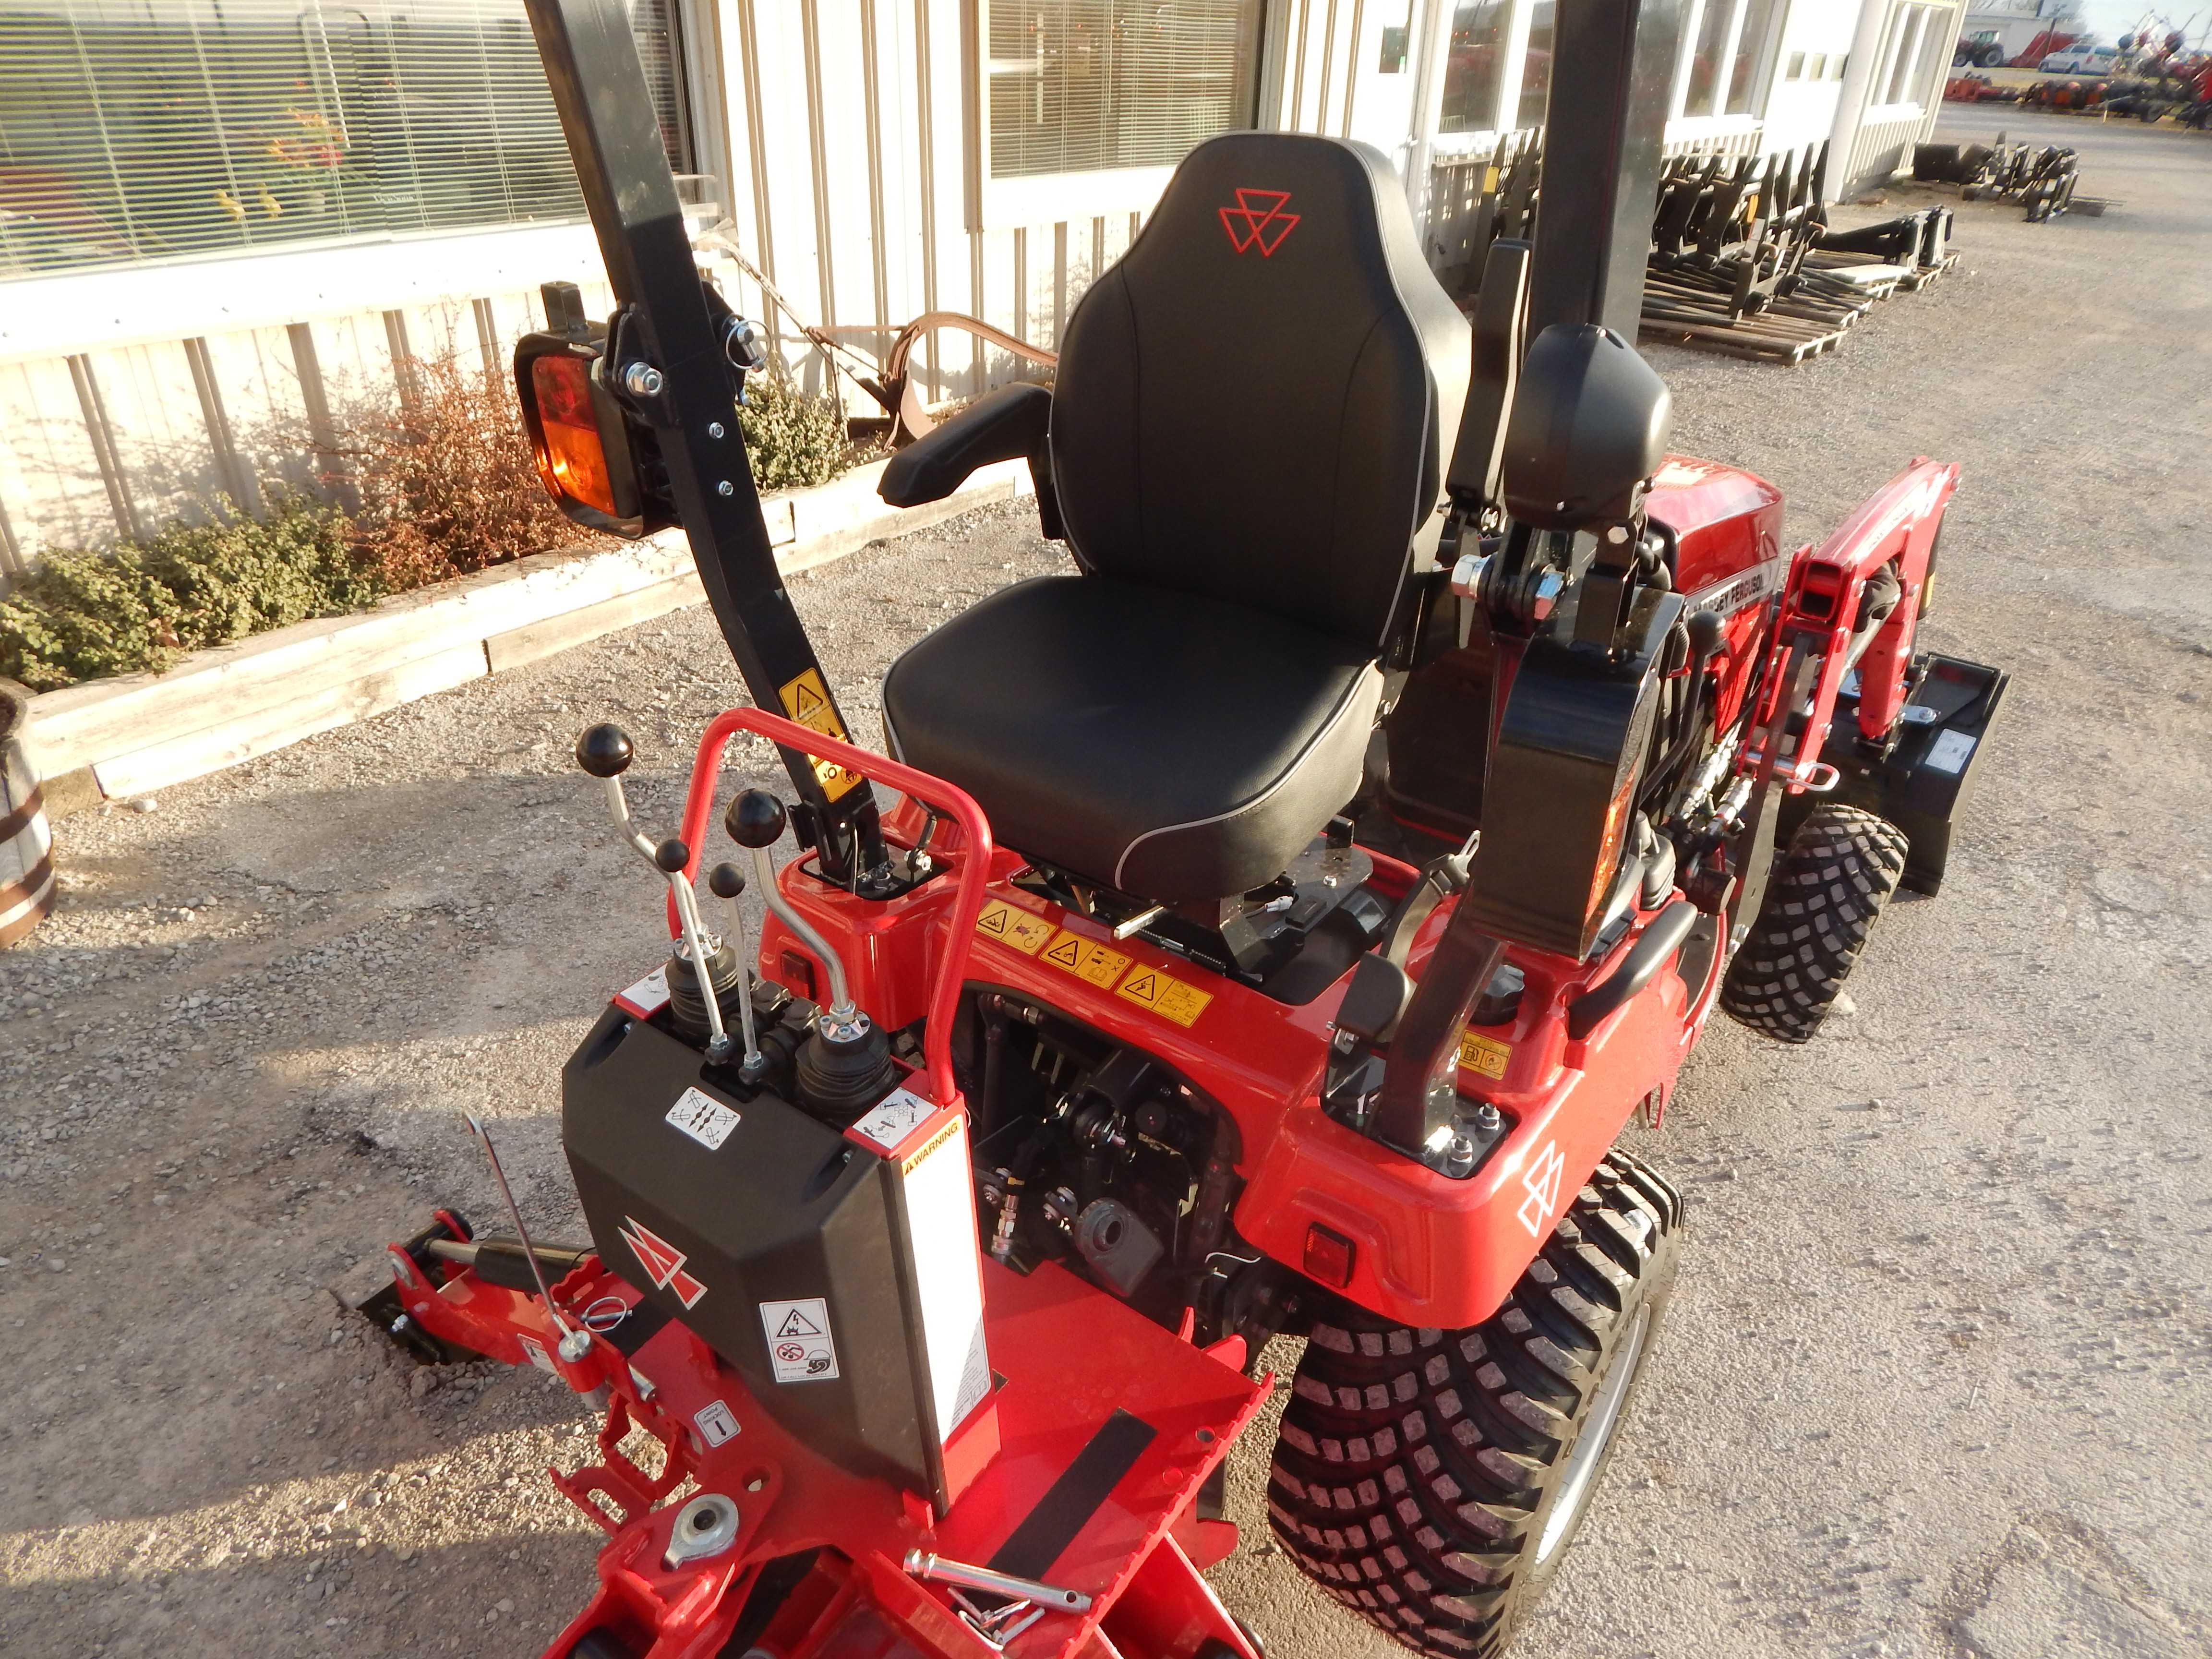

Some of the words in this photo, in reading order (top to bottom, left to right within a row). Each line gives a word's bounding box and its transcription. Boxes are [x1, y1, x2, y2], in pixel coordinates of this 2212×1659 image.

[914, 1122, 958, 1166] WARNING
[703, 1407, 718, 1419] POINT
[703, 1410, 724, 1425] LOCKING
